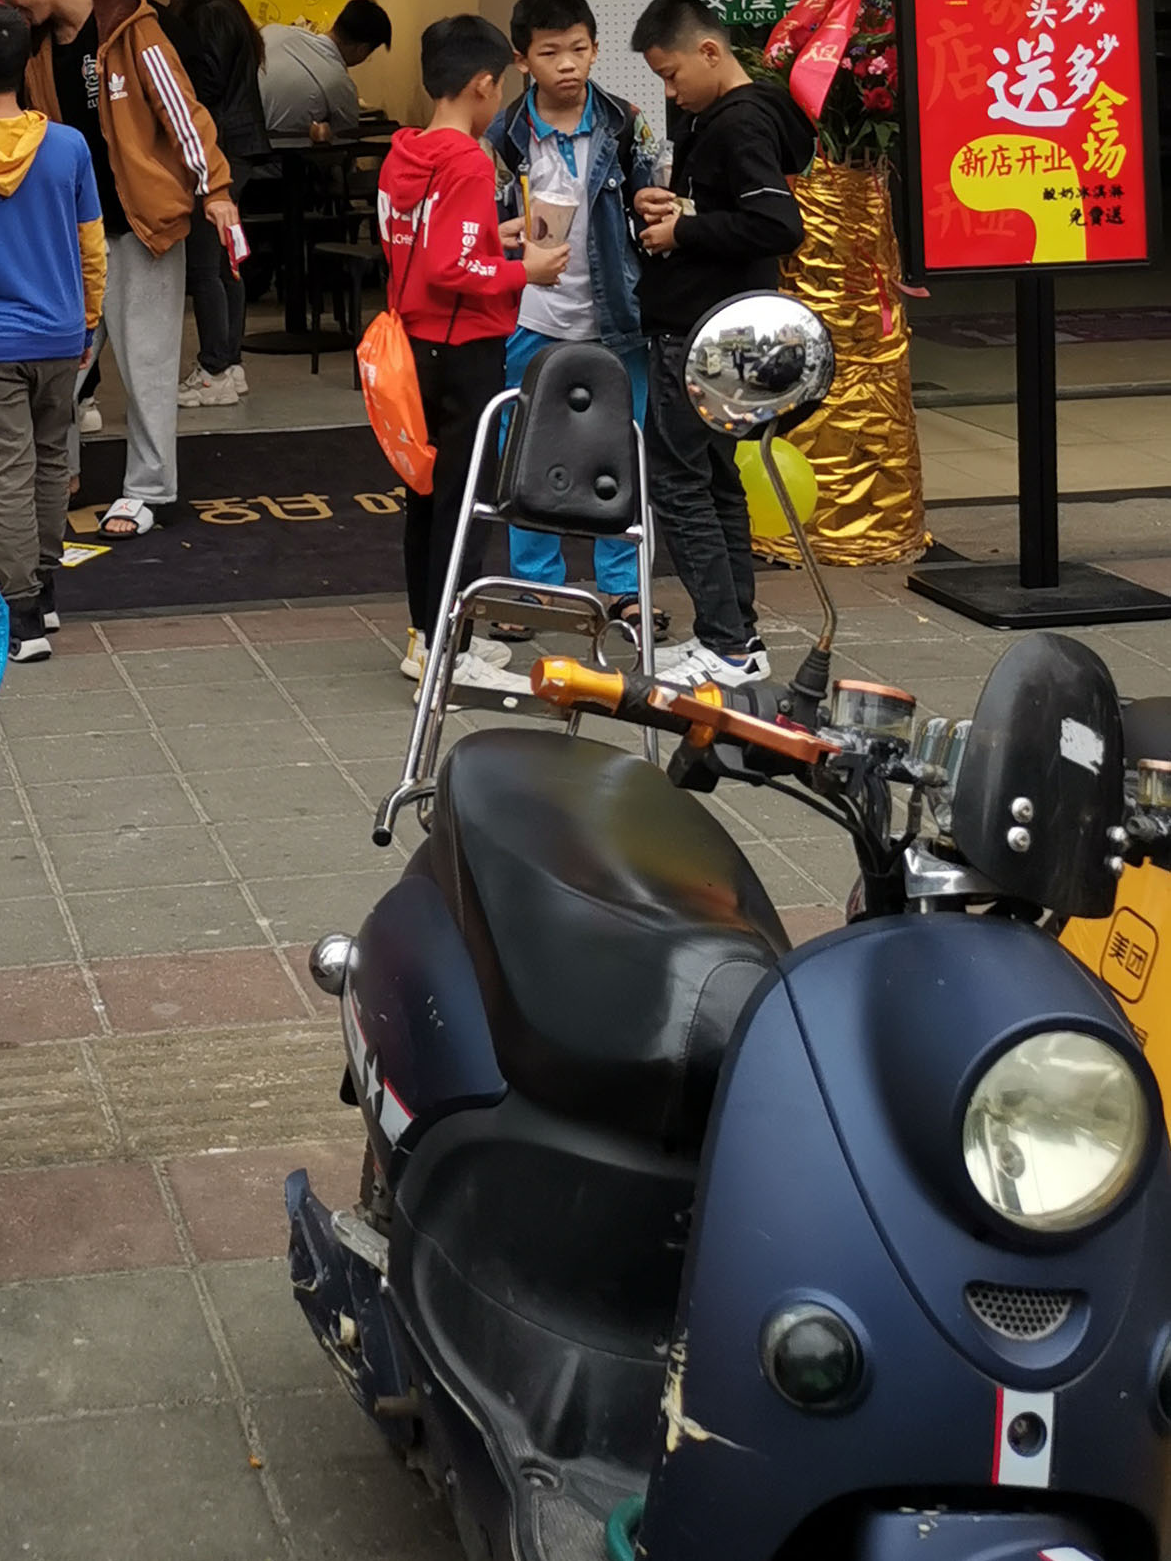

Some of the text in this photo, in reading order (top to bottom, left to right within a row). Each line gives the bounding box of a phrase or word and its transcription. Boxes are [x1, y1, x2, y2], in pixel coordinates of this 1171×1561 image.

[733, 10, 778, 22] LONG
[1082, 81, 1130, 179] 全场
[958, 143, 1072, 180] 新店开业
[1108, 929, 1149, 981] 美团
